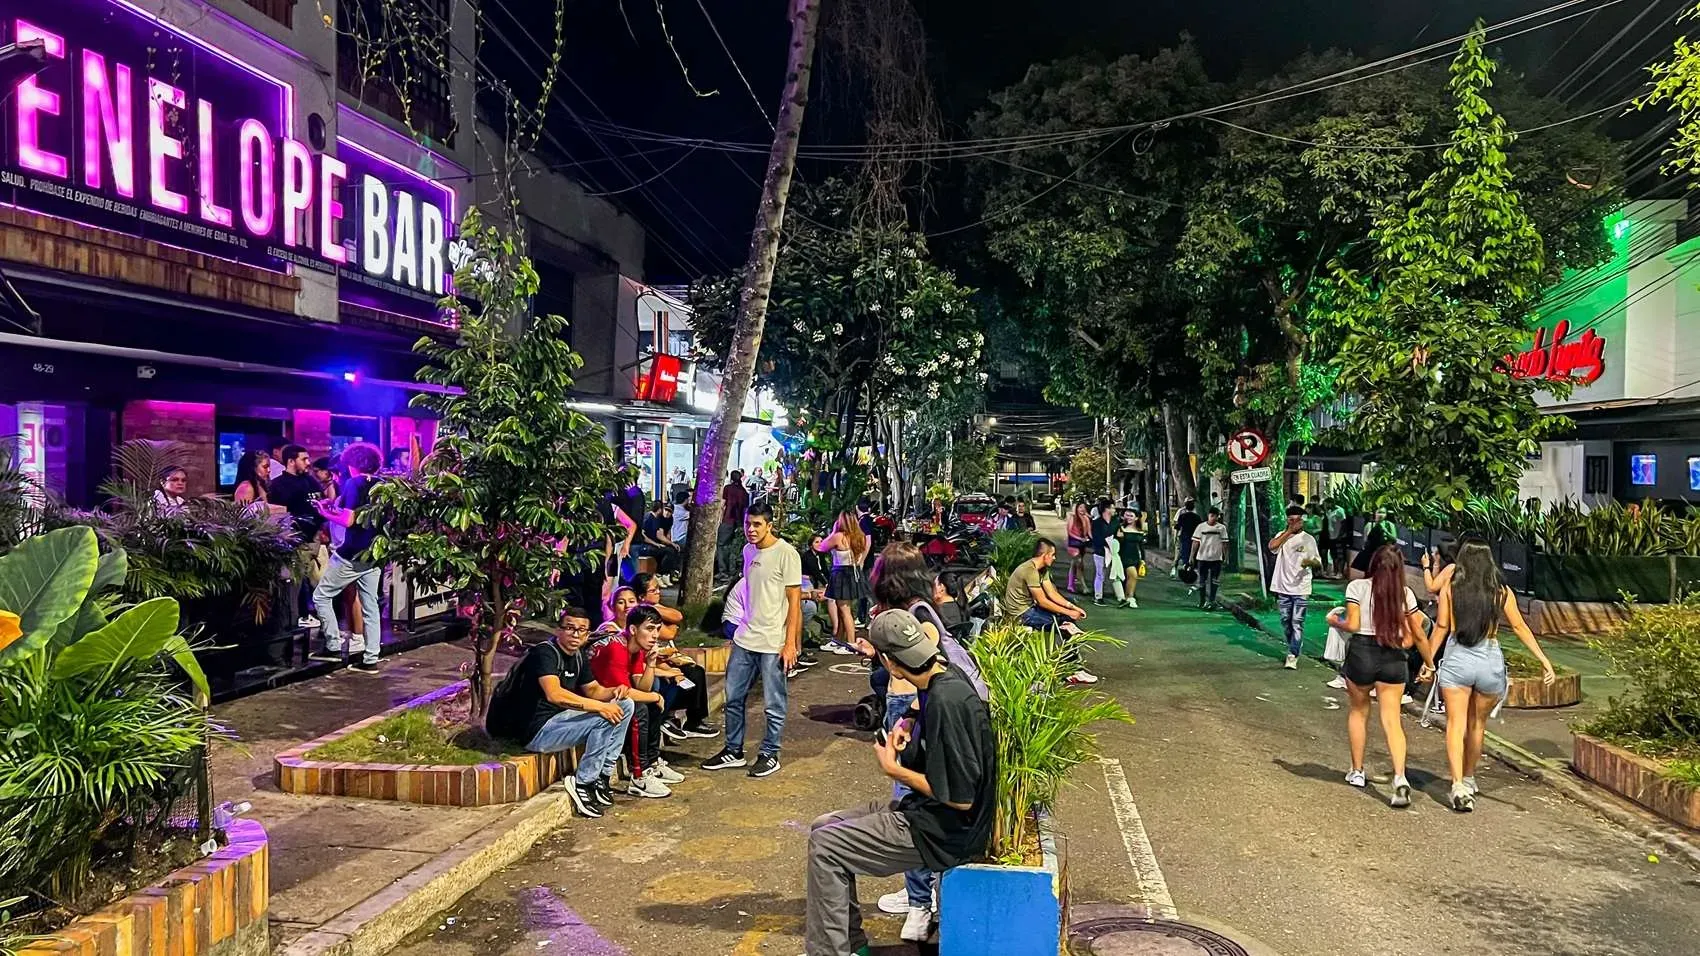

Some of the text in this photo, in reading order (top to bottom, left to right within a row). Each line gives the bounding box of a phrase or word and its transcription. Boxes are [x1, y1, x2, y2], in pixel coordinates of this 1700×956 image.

[15, 18, 445, 296] ENELOPE BAR
[1, 171, 26, 188] SALUD.
[65, 187, 74, 201] EL
[104, 198, 114, 212] DE
[32, 362, 55, 374] 48-29
